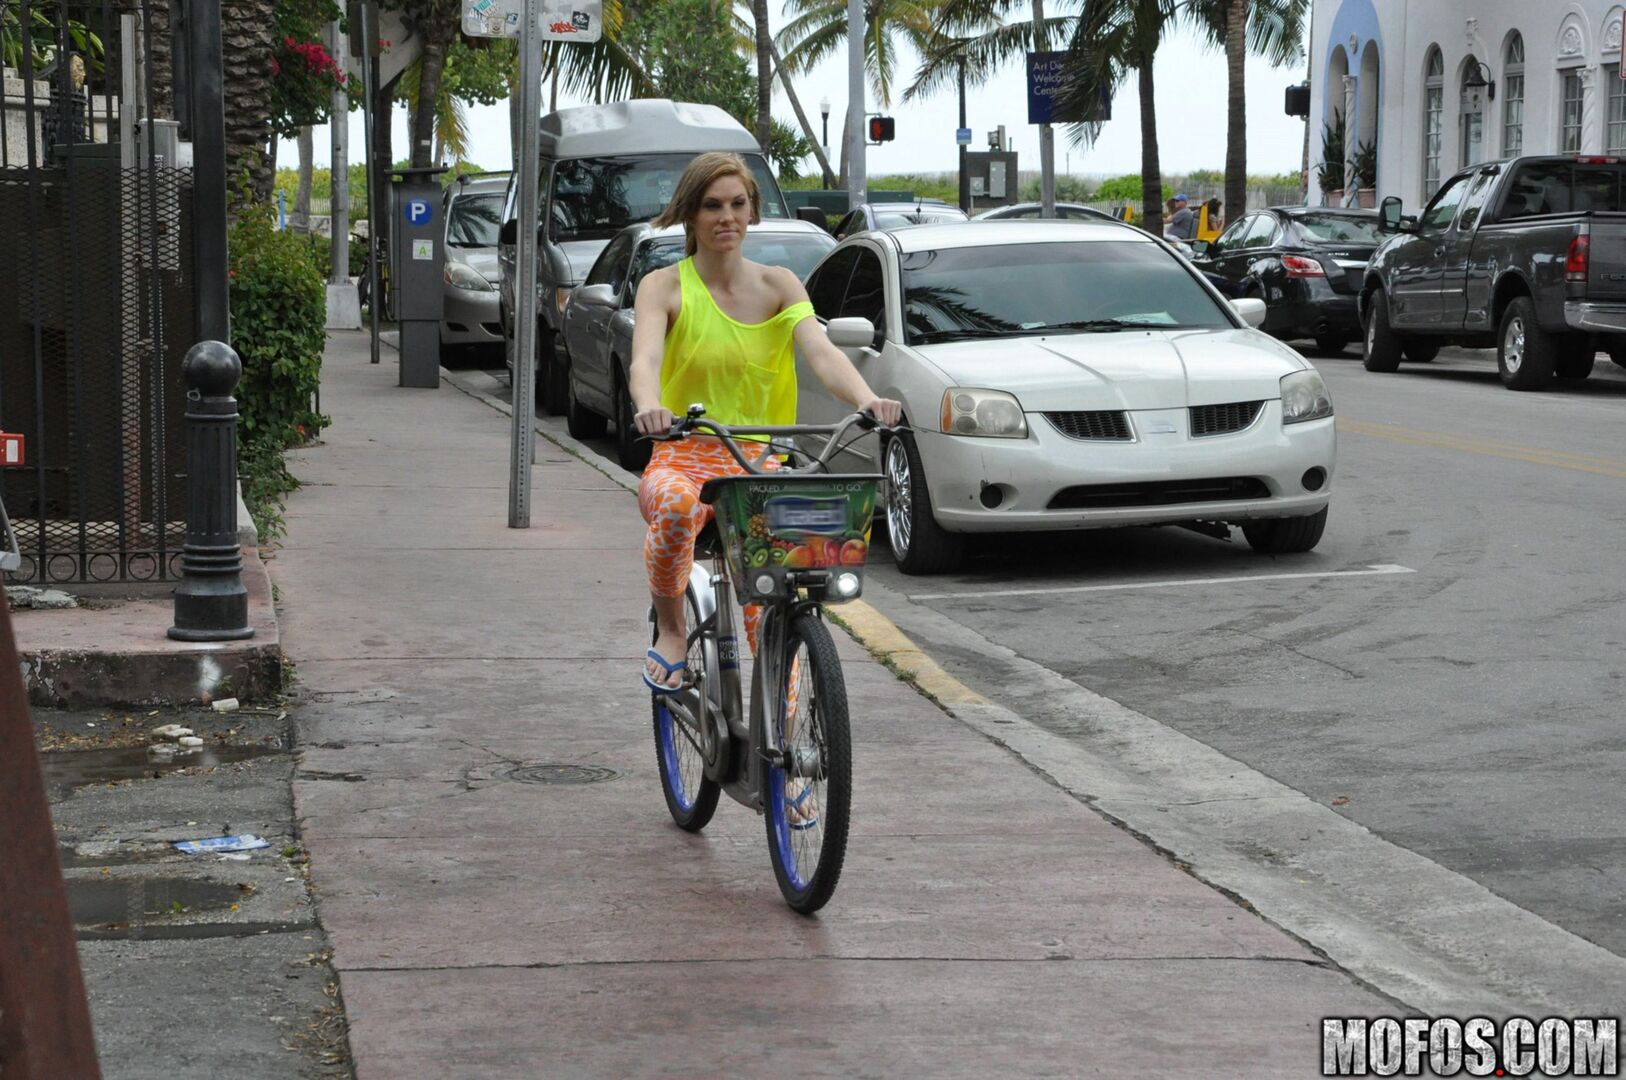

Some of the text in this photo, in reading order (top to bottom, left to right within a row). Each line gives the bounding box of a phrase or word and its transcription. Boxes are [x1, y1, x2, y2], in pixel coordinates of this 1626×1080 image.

[1033, 62, 1048, 71] Art
[411, 202, 426, 221] P
[418, 246, 427, 257] A
[749, 484, 780, 493] PACKED
[832, 484, 844, 492] TO
